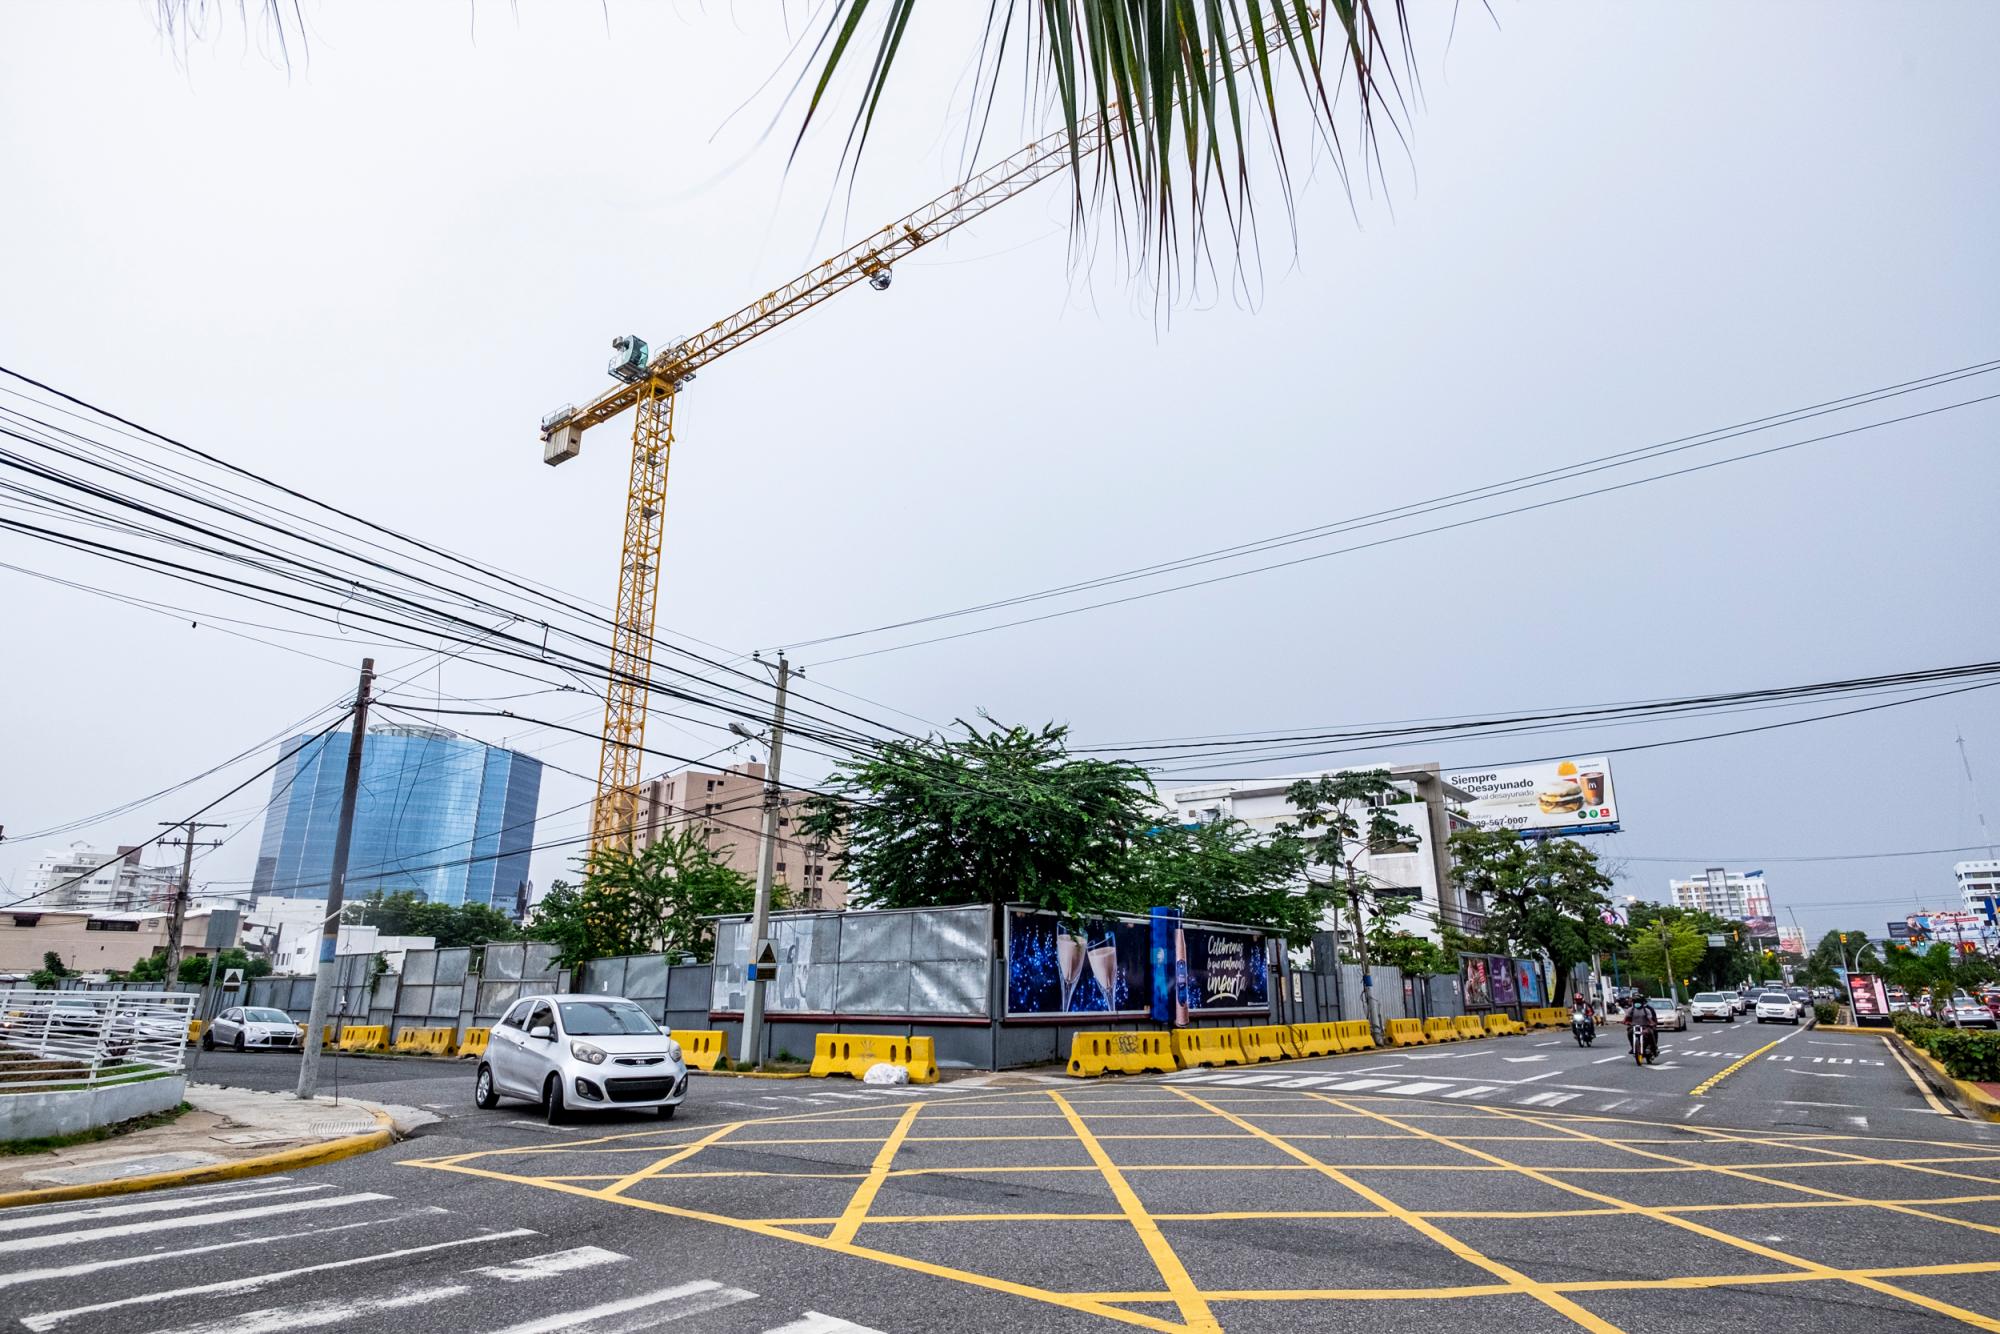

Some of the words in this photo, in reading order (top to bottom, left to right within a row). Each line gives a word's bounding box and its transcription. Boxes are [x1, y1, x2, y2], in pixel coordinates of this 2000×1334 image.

[1451, 773, 1497, 785] Siempre
[1458, 778, 1534, 793] cDesayunado
[1489, 789, 1534, 800] desayunado
[1207, 970, 1247, 999] importa
